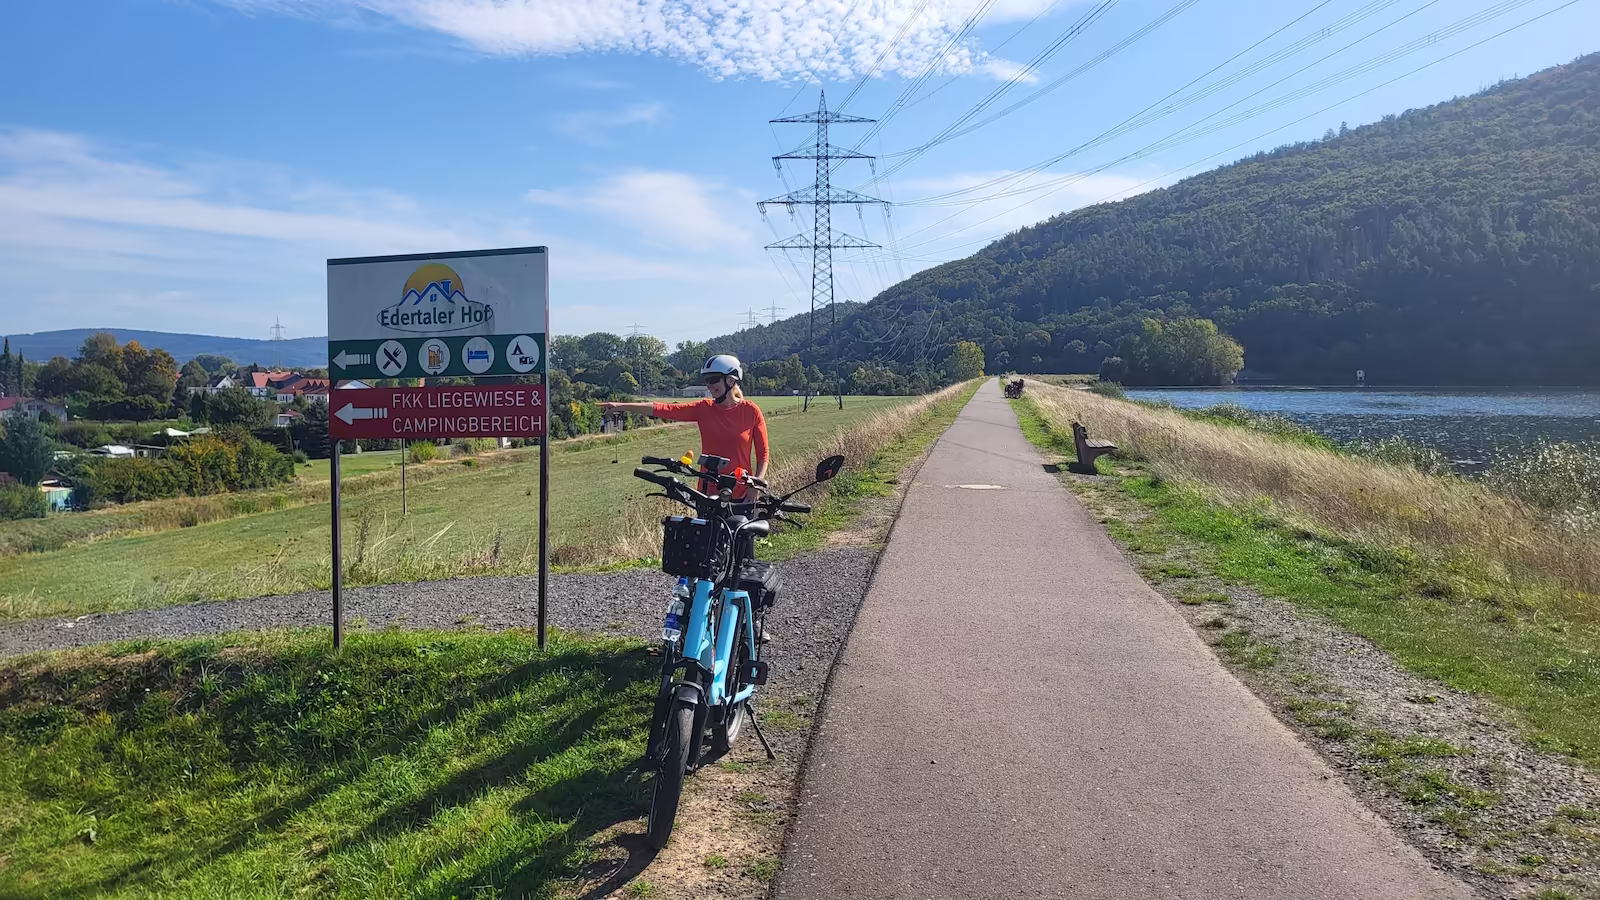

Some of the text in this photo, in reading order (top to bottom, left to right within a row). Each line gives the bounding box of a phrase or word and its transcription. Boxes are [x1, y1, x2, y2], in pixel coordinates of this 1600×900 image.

[380, 304, 491, 327] Edertaler Hof
[392, 390, 542, 409] FKK LIEGEWIESE &
[392, 415, 542, 433] CAMPINGBEREICH
